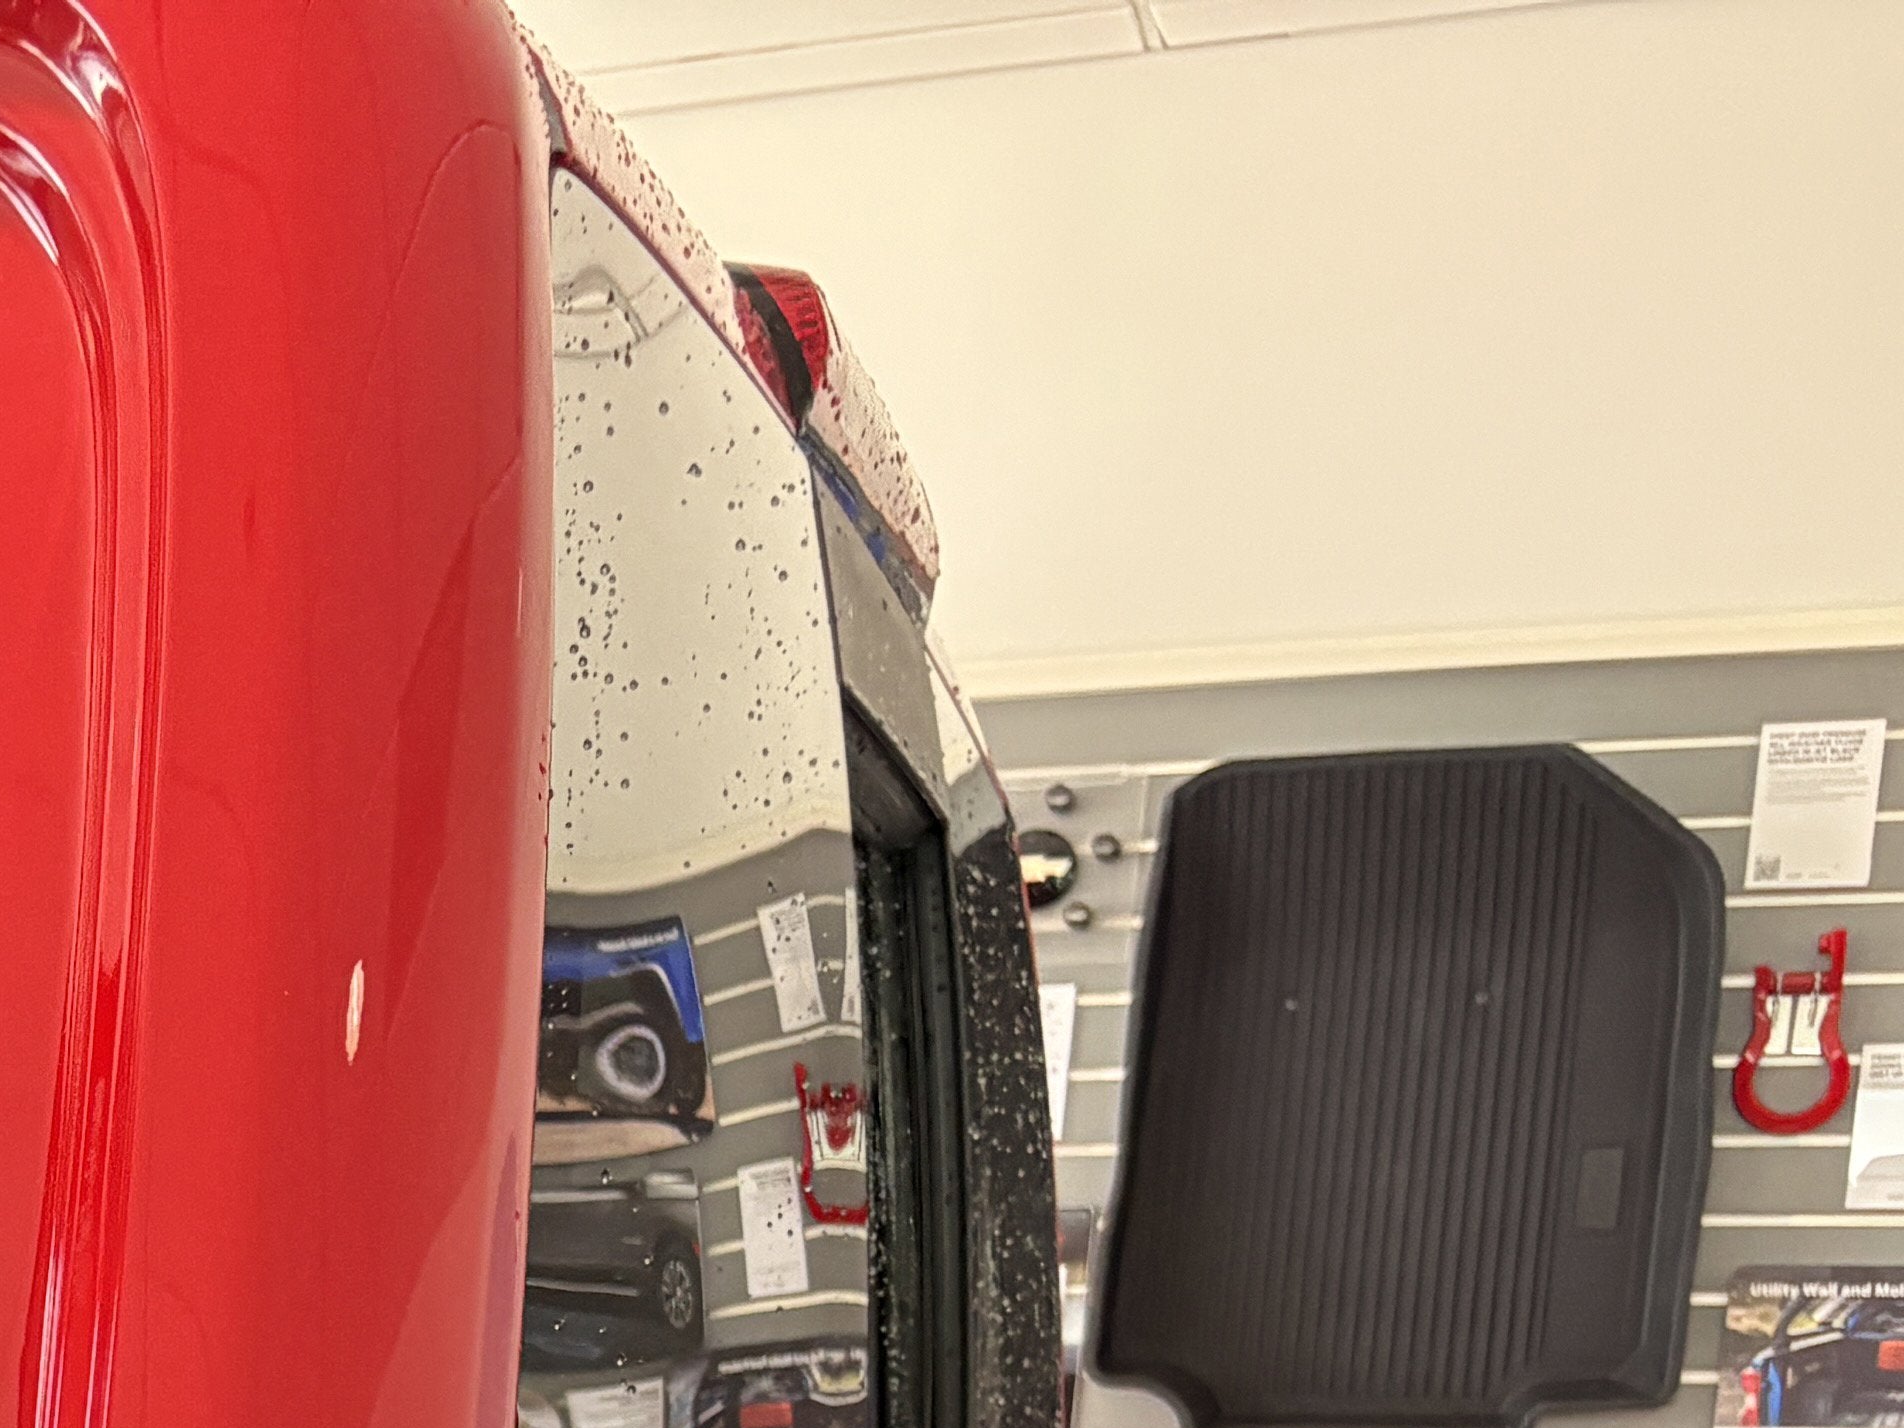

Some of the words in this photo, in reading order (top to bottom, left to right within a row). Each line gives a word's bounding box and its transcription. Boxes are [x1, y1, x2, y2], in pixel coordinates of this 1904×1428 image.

[1750, 1282, 1799, 1300] Utility
[1803, 1281, 1838, 1297] Wall
[1841, 1282, 1872, 1298] and
